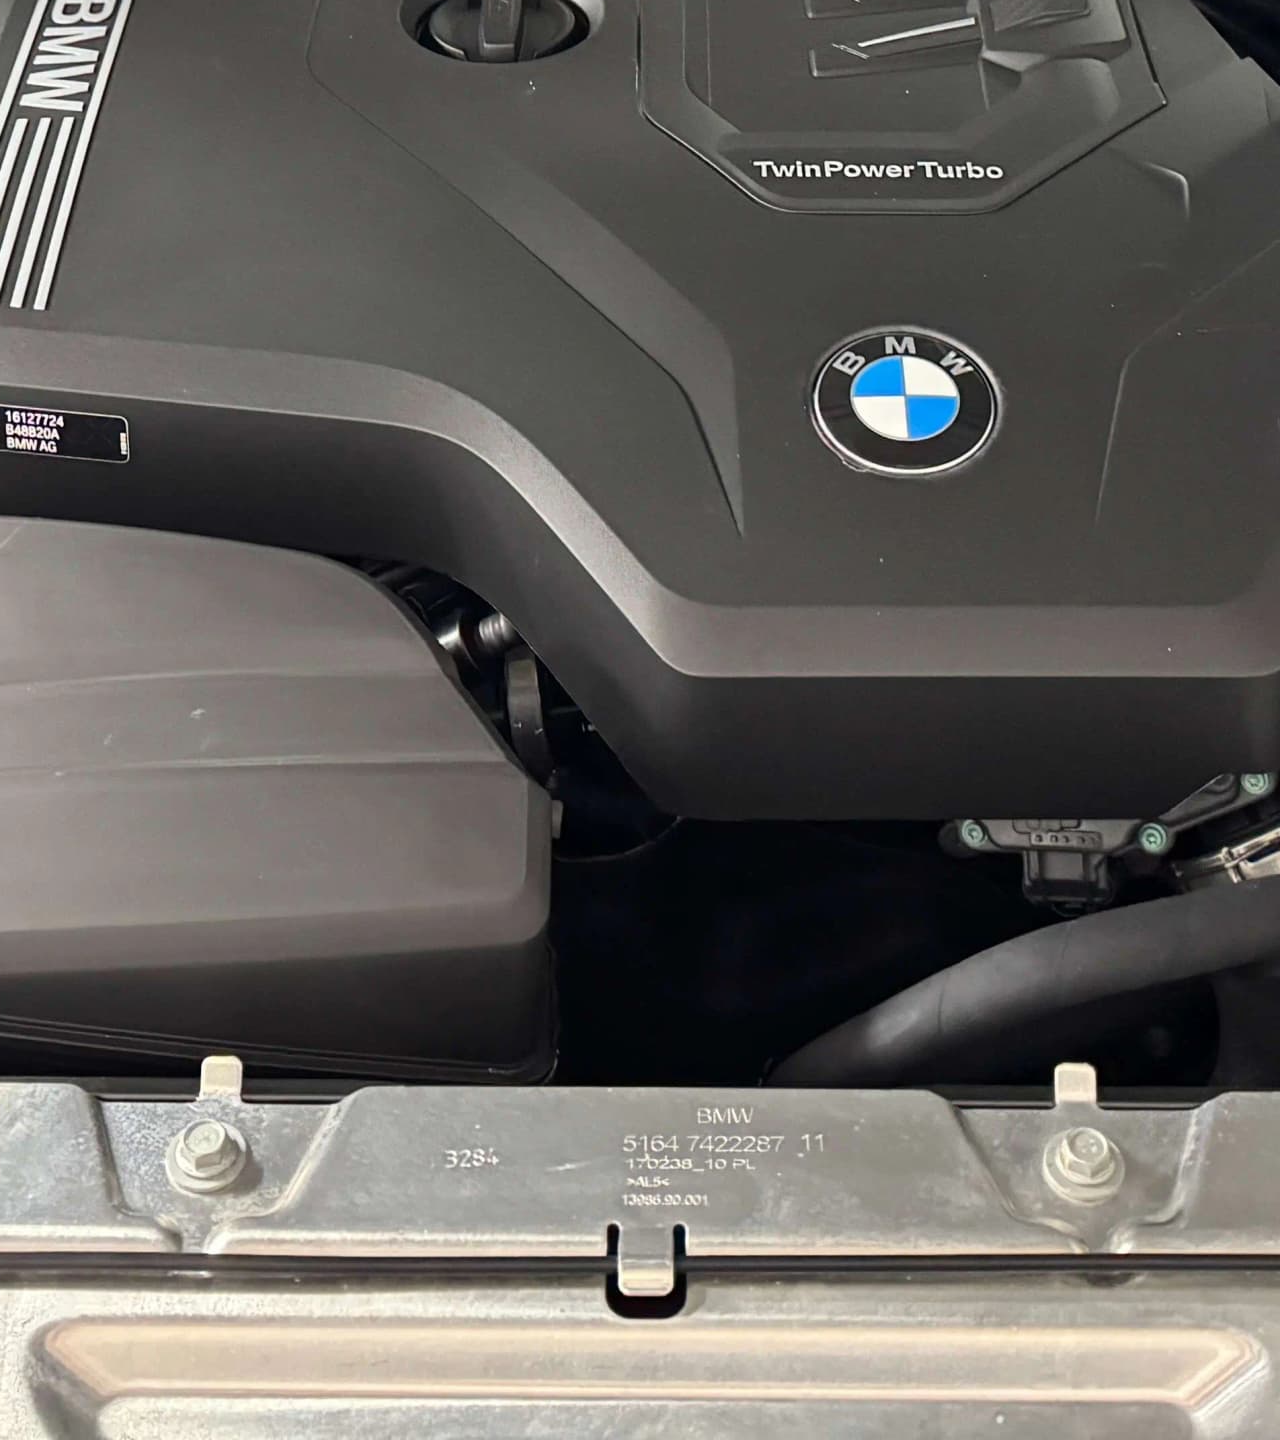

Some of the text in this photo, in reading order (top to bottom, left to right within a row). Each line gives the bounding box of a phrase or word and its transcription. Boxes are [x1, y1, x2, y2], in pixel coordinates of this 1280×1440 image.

[753, 160, 1004, 179] TwinPower Turbo
[832, 336, 974, 377] BMW
[4, 410, 65, 427] 16127724
[5, 423, 60, 440] B48B20A
[6, 436, 58, 453] BMW AG
[697, 1107, 754, 1125] BMW
[623, 1135, 680, 1153] 5164
[687, 1135, 785, 1153] 7422287
[444, 1147, 500, 1168] 3284
[732, 1158, 757, 1171] PL
